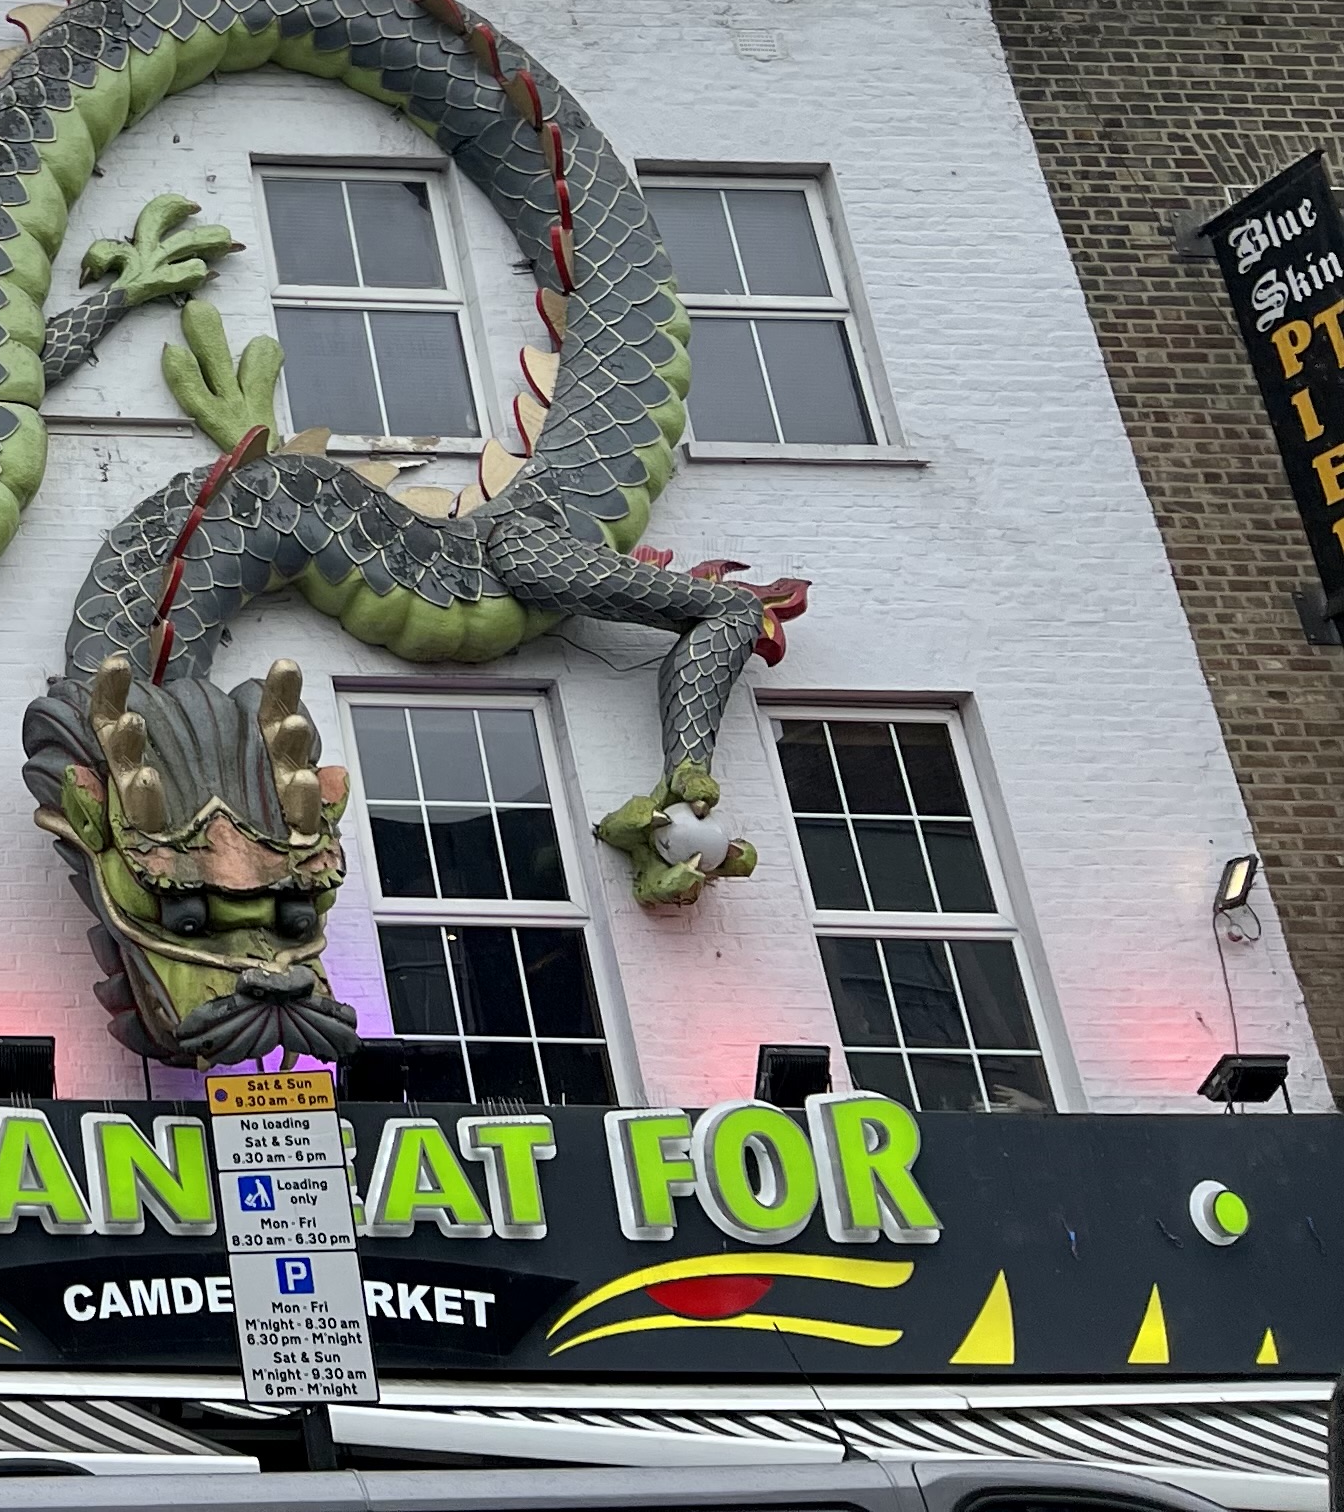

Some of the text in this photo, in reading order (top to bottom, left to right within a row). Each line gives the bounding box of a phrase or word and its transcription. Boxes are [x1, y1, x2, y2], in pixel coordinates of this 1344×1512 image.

[1228, 197, 1317, 275] Blue
[1252, 252, 1344, 332] Skin
[248, 1079, 312, 1091] Sat & Sun
[236, 1096, 265, 1107] 9.30
[269, 1097, 287, 1106] am
[298, 1094, 305, 1104] 6
[309, 1094, 328, 1106] pm
[240, 1118, 310, 1130] No loading
[245, 1136, 310, 1148] Sat & Sun
[233, 1152, 263, 1164] 9.30
[267, 1154, 285, 1163] am
[296, 1151, 303, 1161] 6
[307, 1152, 326, 1162] pm
[338, 1115, 556, 1240] AT
[607, 1091, 942, 1244] FOR
[277, 1179, 327, 1190] Loading
[291, 1194, 317, 1206] only
[261, 1218, 288, 1229] Mon
[299, 1217, 316, 1228] Fri
[232, 1234, 262, 1246] 8.30
[266, 1236, 285, 1245] am
[296, 1233, 326, 1244] 6.30
[330, 1234, 350, 1246] pm
[285, 1261, 307, 1291] P
[63, 1276, 234, 1321] CAMDE
[272, 1302, 300, 1313] Mon
[311, 1301, 328, 1313] Fri
[246, 1319, 294, 1332] M'night
[305, 1318, 336, 1329] 8.30
[341, 1320, 360, 1328] am
[247, 1334, 278, 1345] 6.30
[282, 1335, 301, 1346] pm
[312, 1333, 362, 1346] M'night
[274, 1351, 340, 1363] Sat & Sun
[253, 1369, 302, 1382] M'night
[312, 1368, 343, 1380] 9.30
[348, 1370, 366, 1379] am
[265, 1384, 273, 1395] 6
[277, 1386, 296, 1397] pm
[307, 1383, 357, 1396] M'night
